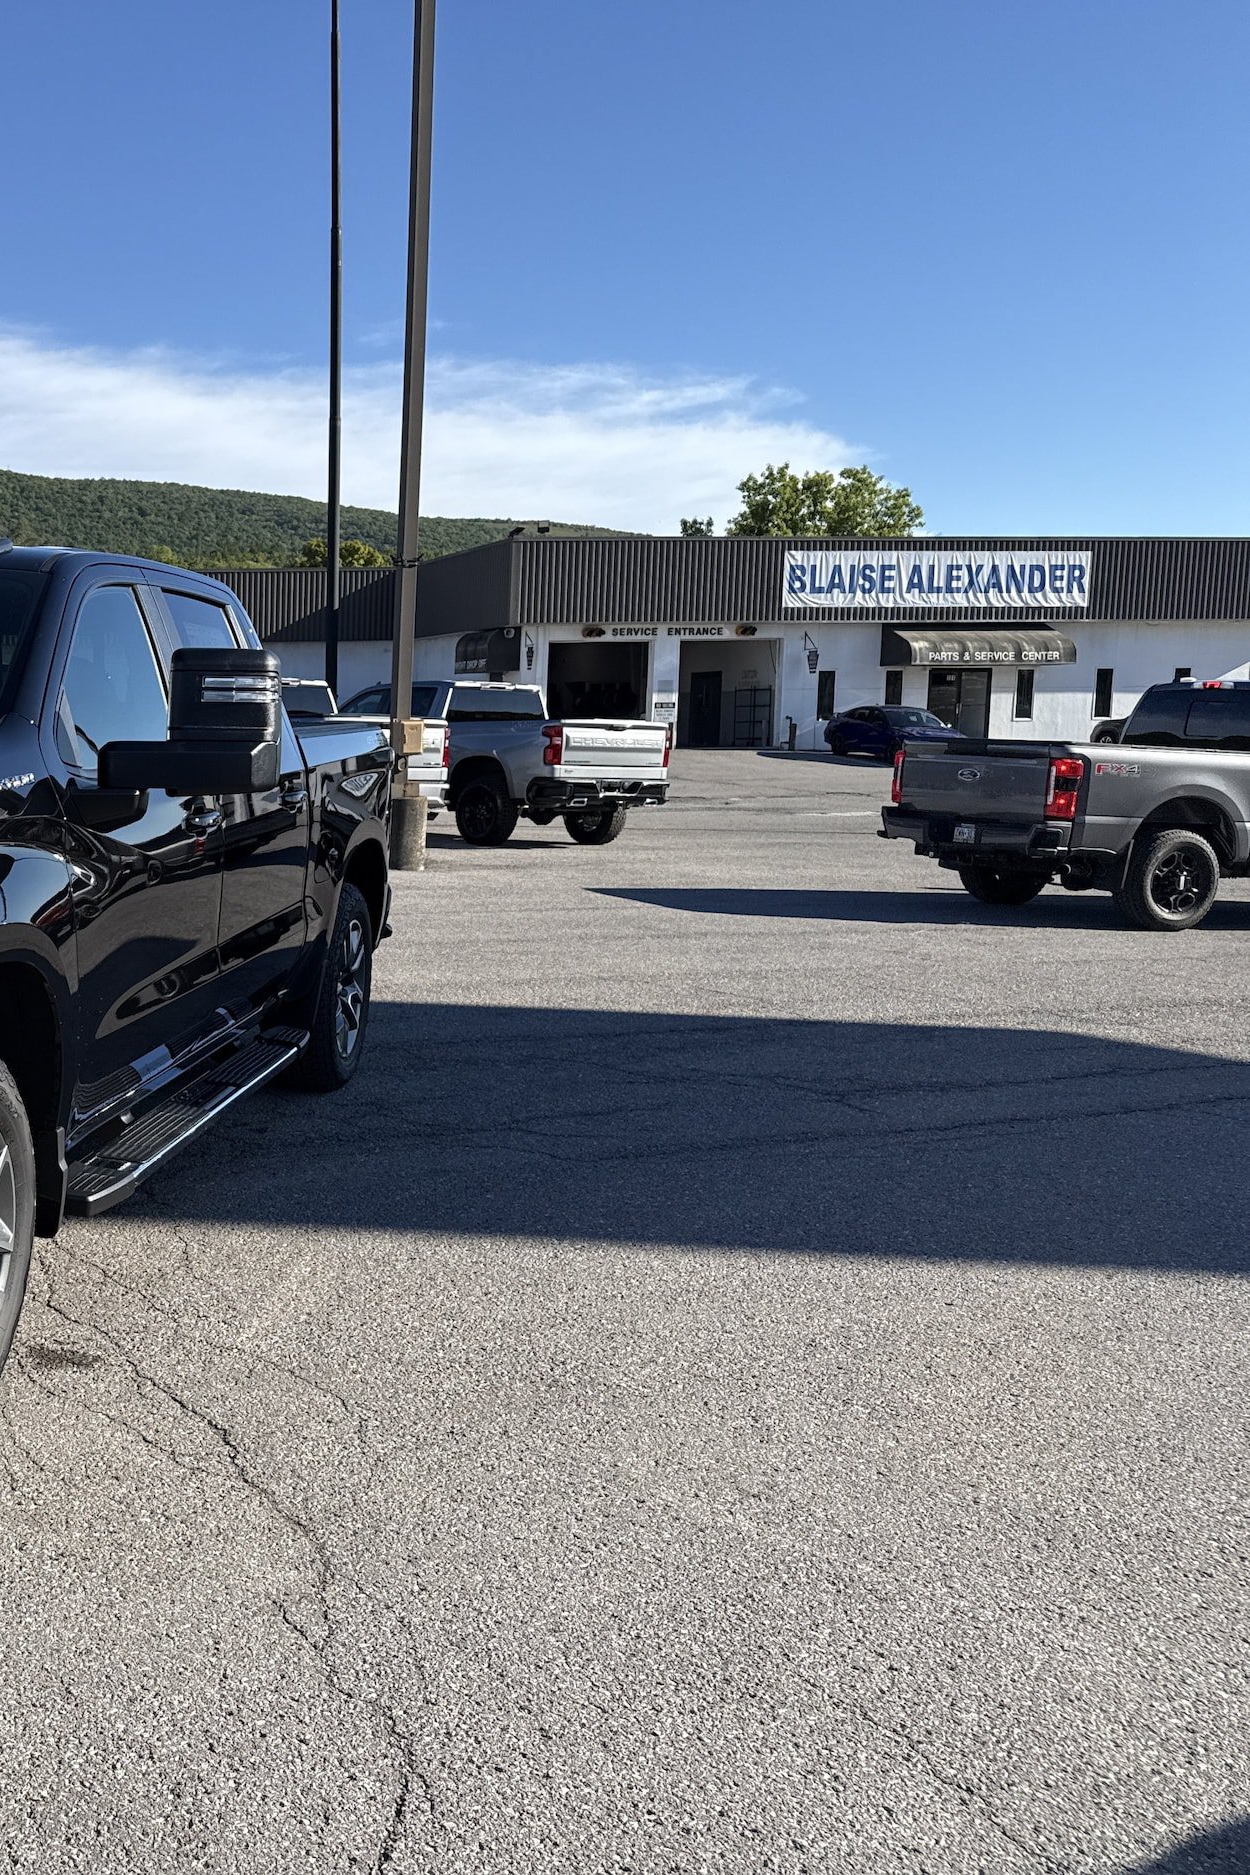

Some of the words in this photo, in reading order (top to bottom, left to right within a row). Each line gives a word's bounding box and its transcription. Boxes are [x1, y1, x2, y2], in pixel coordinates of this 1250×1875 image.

[788, 564, 896, 594] BLAISE
[905, 564, 1086, 594] ALEXANDER
[612, 627, 658, 636] SERVICE
[667, 626, 724, 636] ENTRANCE
[929, 651, 960, 661] PARTS
[963, 651, 971, 661] &
[974, 651, 1016, 661] SERVICE
[1021, 651, 1061, 661] CENTER
[1094, 763, 1141, 775] FX4
